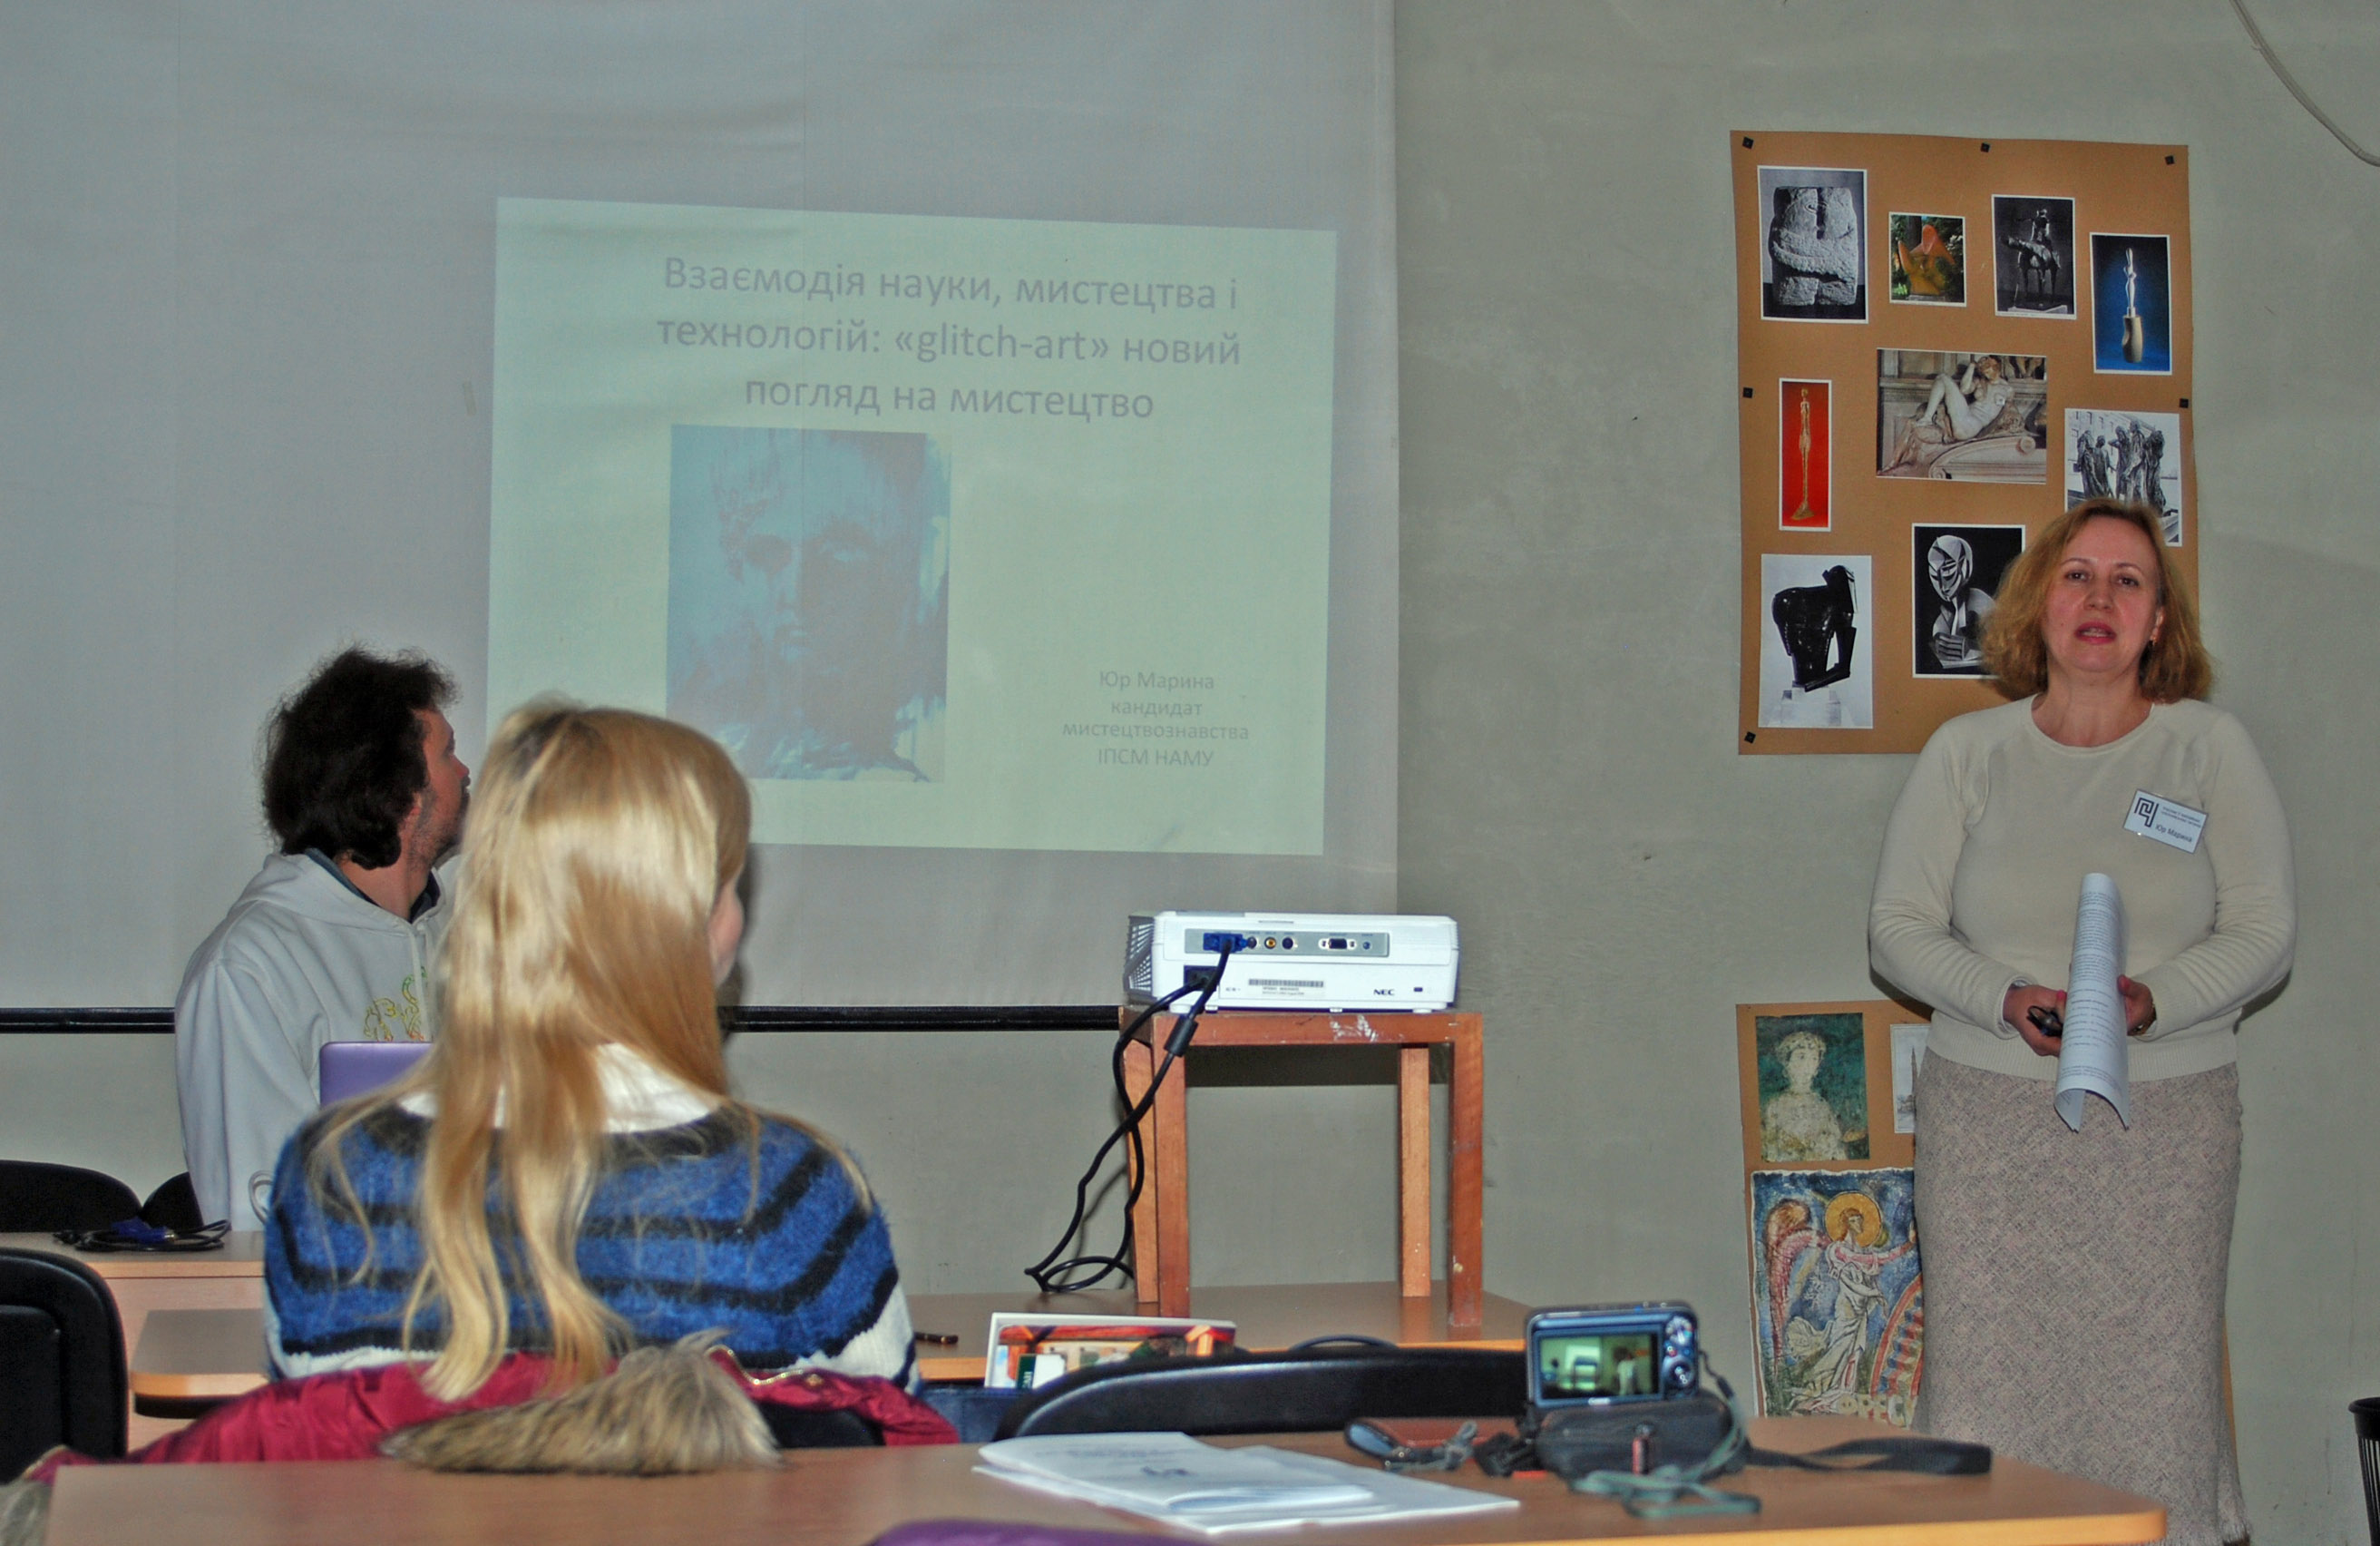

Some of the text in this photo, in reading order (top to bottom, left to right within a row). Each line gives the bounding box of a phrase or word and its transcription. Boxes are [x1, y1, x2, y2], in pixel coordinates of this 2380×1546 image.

[665, 257, 1237, 313] Взаємодія науки, мистецтва і
[657, 318, 1241, 365] технологій: «glitch-art» новий
[746, 380, 1154, 423] погляд на мистецтво
[1099, 670, 1214, 691] Юр Марина
[1111, 701, 1204, 718] кандидат
[1062, 723, 1250, 739] мистецтвознавства
[1098, 749, 1214, 767] ІПСМ НАМУ
[1373, 988, 1395, 996] NEC
